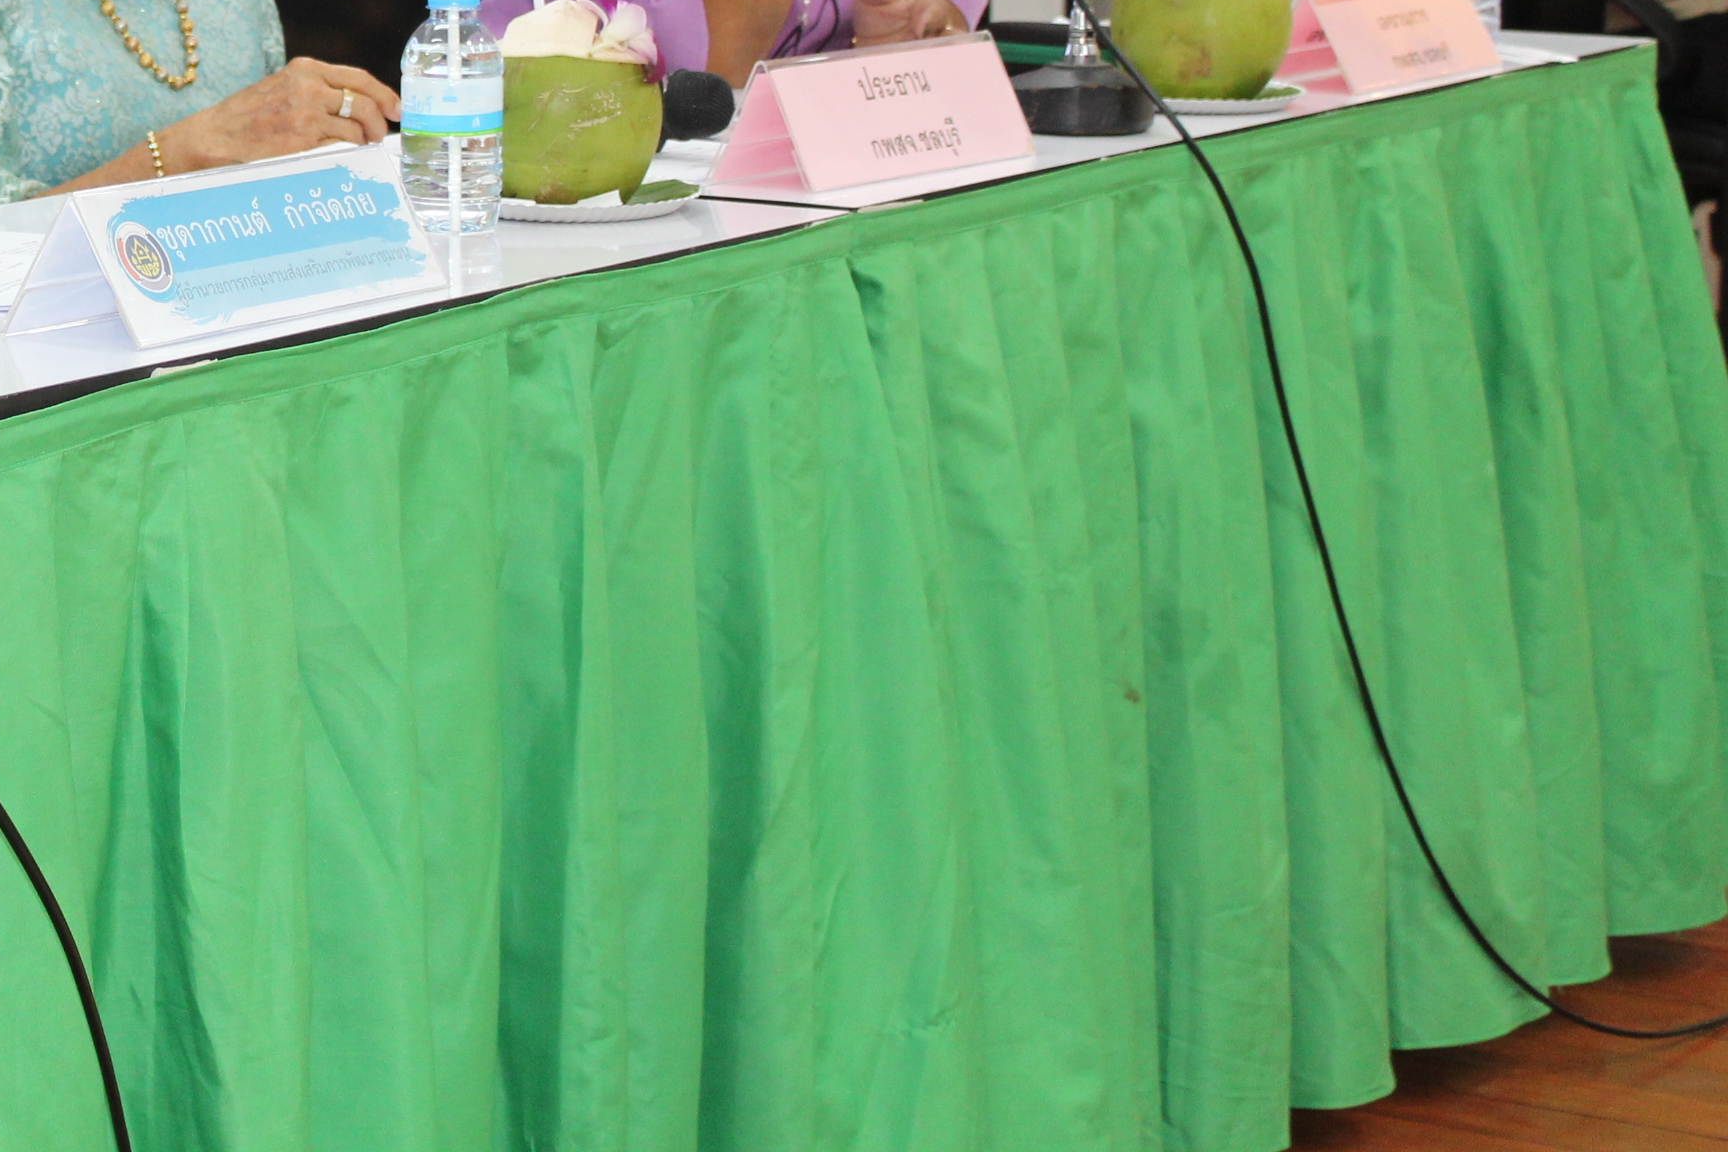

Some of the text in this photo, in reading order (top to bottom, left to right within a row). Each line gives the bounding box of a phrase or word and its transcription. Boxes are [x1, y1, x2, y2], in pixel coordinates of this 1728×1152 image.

[857, 66, 931, 101] ประธาน
[156, 181, 378, 262] ชุดากานต์ กำจัดภัย
